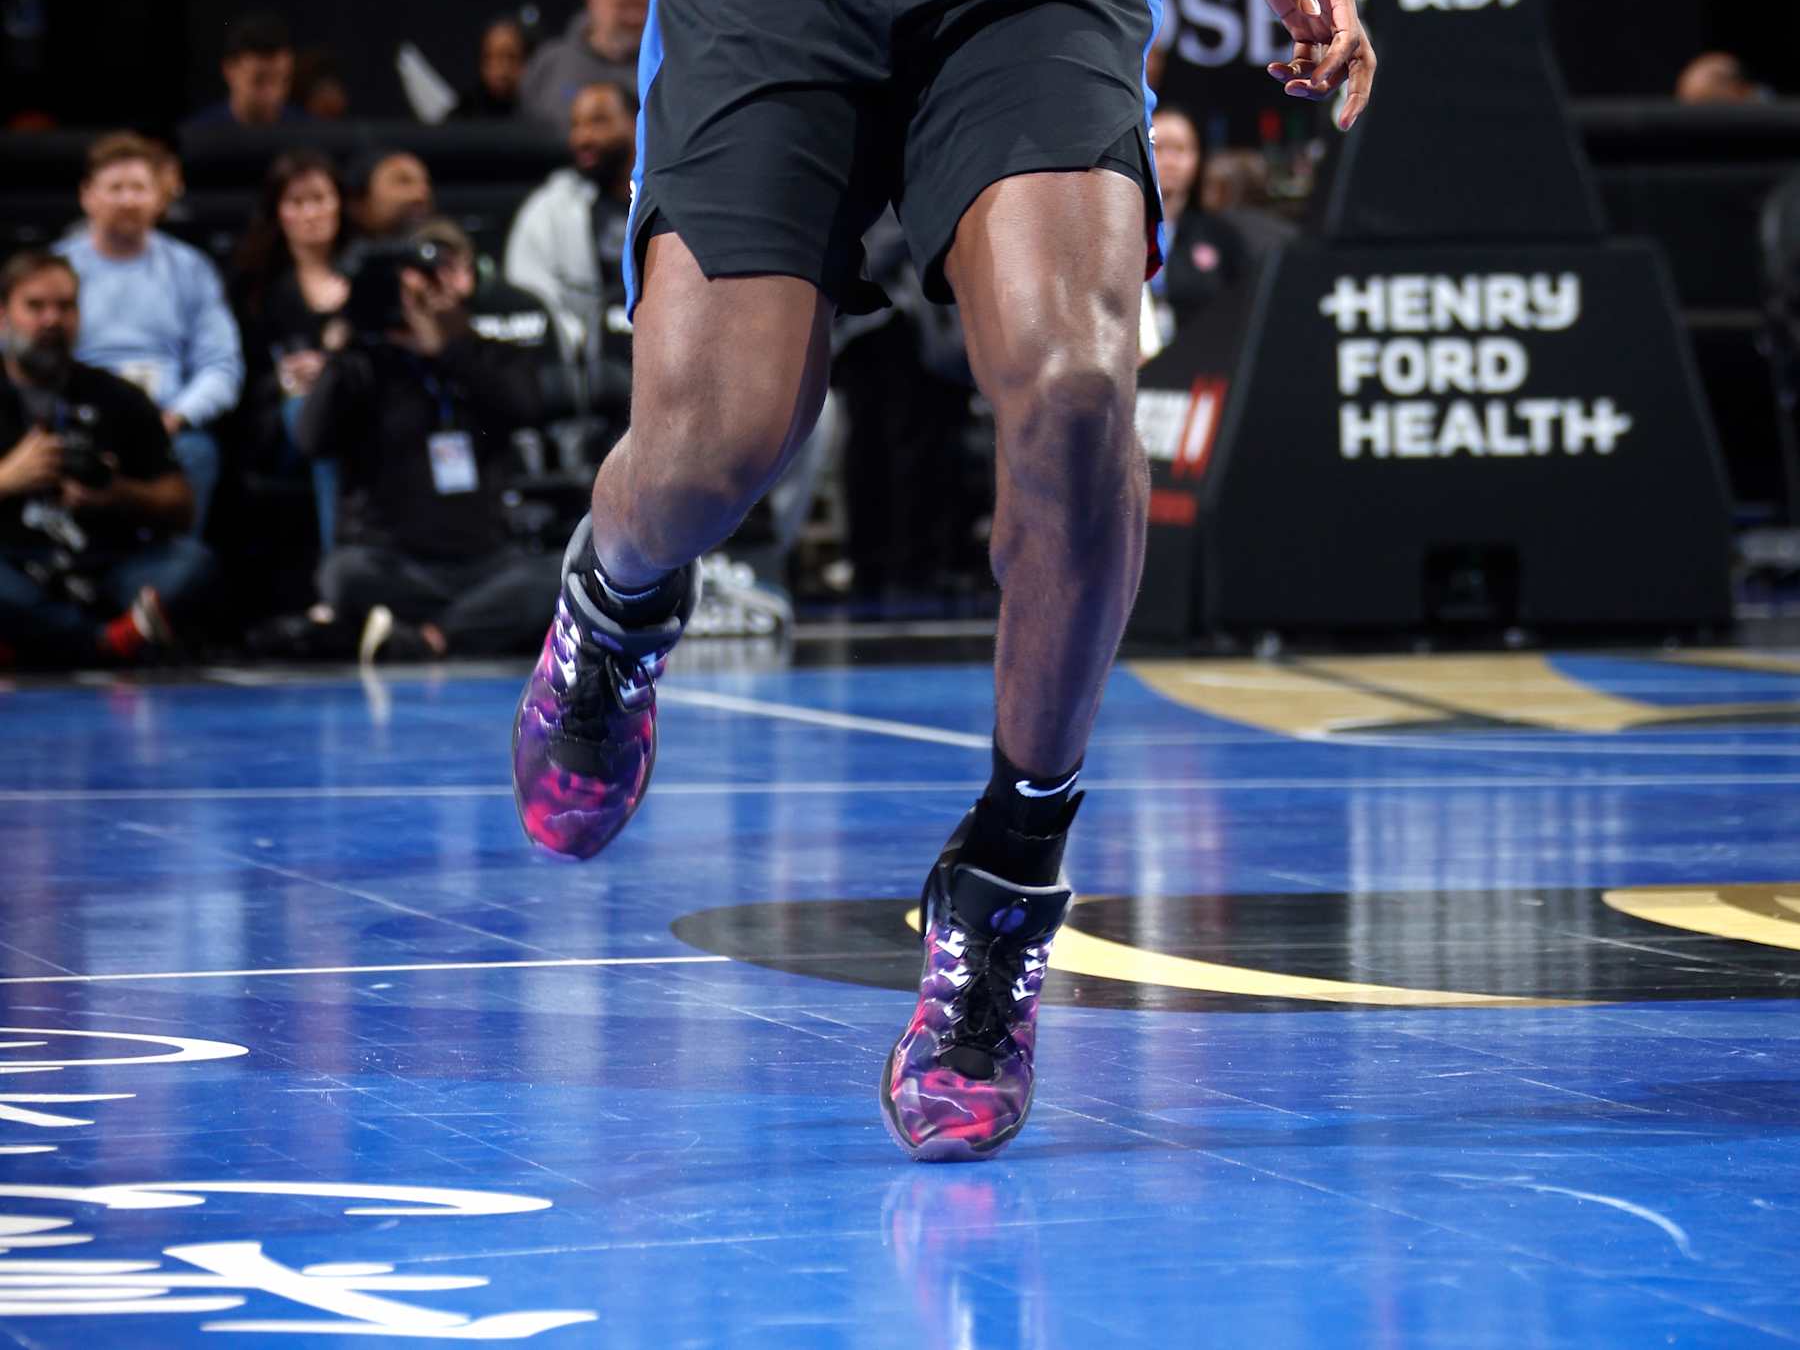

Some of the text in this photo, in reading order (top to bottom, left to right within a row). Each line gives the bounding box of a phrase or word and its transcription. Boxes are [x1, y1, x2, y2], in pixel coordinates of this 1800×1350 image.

[1319, 273, 1580, 332] HENRY
[1337, 337, 1528, 394] FORD
[1340, 399, 1631, 458] HEALTH
